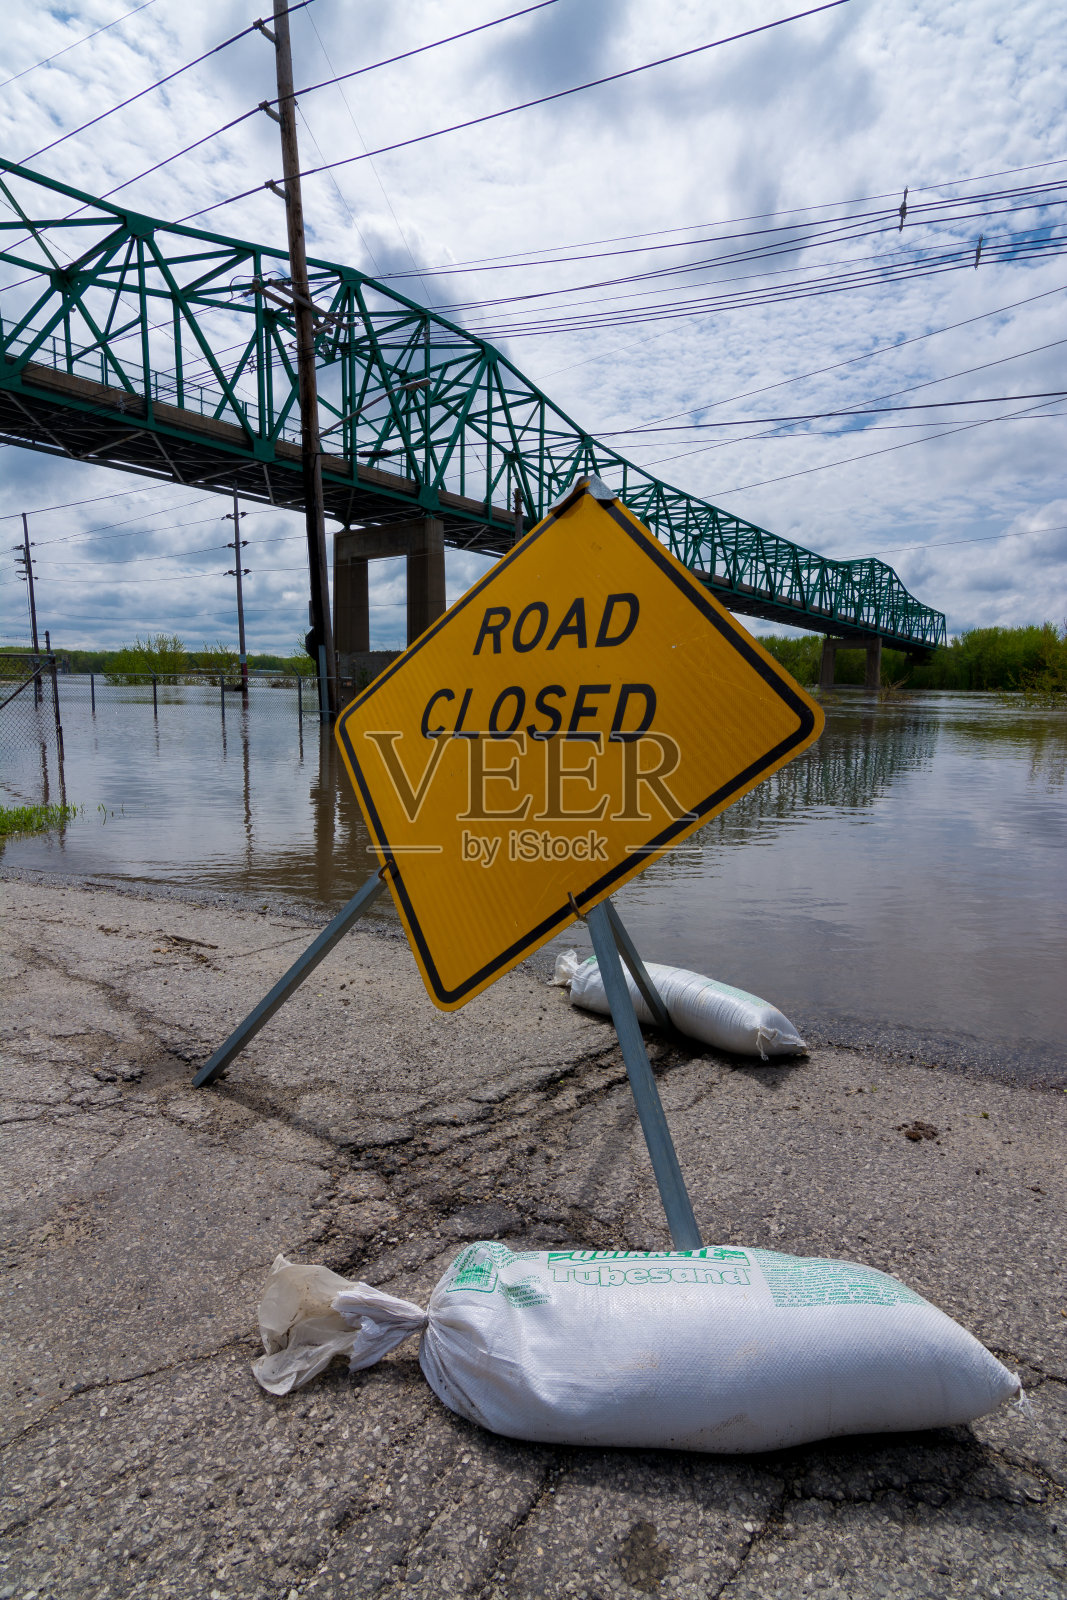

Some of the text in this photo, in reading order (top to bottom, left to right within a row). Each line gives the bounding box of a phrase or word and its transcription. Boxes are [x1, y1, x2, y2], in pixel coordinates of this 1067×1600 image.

[472, 592, 640, 656] ROAD
[420, 683, 657, 743] CLOSED
[548, 1264, 750, 1287] Tubesand
